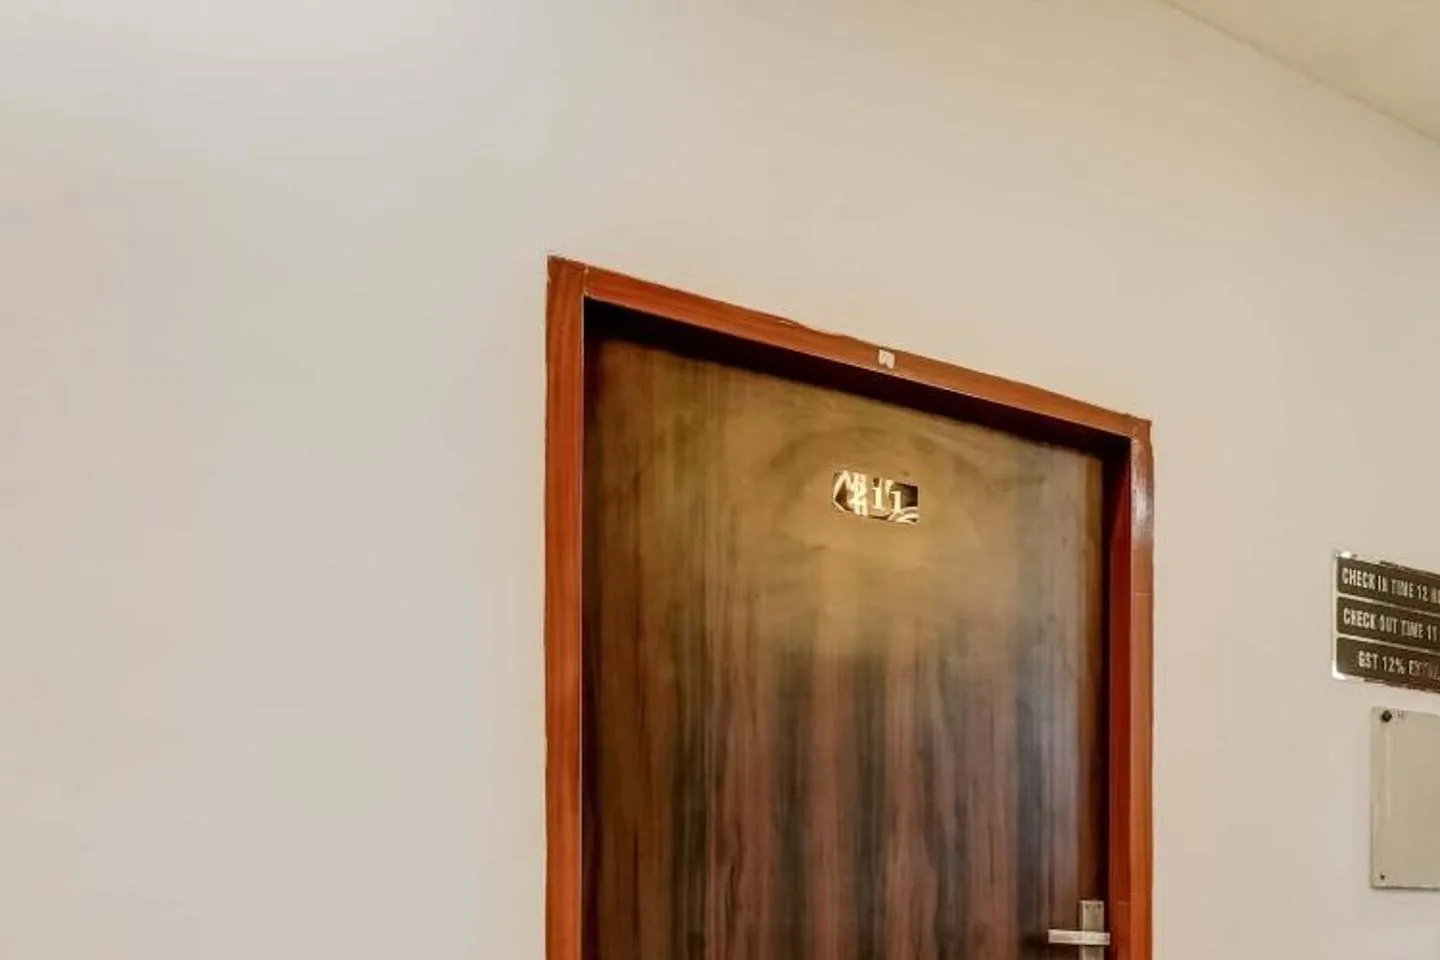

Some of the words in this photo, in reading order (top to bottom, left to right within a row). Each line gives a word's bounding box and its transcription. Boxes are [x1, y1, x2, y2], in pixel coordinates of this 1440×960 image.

[1341, 567, 1376, 590] CHECK
[1378, 575, 1388, 592] IN
[1392, 578, 1414, 598] TIME
[1417, 584, 1429, 601] 12
[1343, 607, 1376, 630] CHECK
[1379, 615, 1398, 634] OUT
[1401, 619, 1423, 640] TIME
[1427, 624, 1438, 641] 11
[1358, 650, 1379, 671] GST
[1382, 655, 1406, 675] 12%
